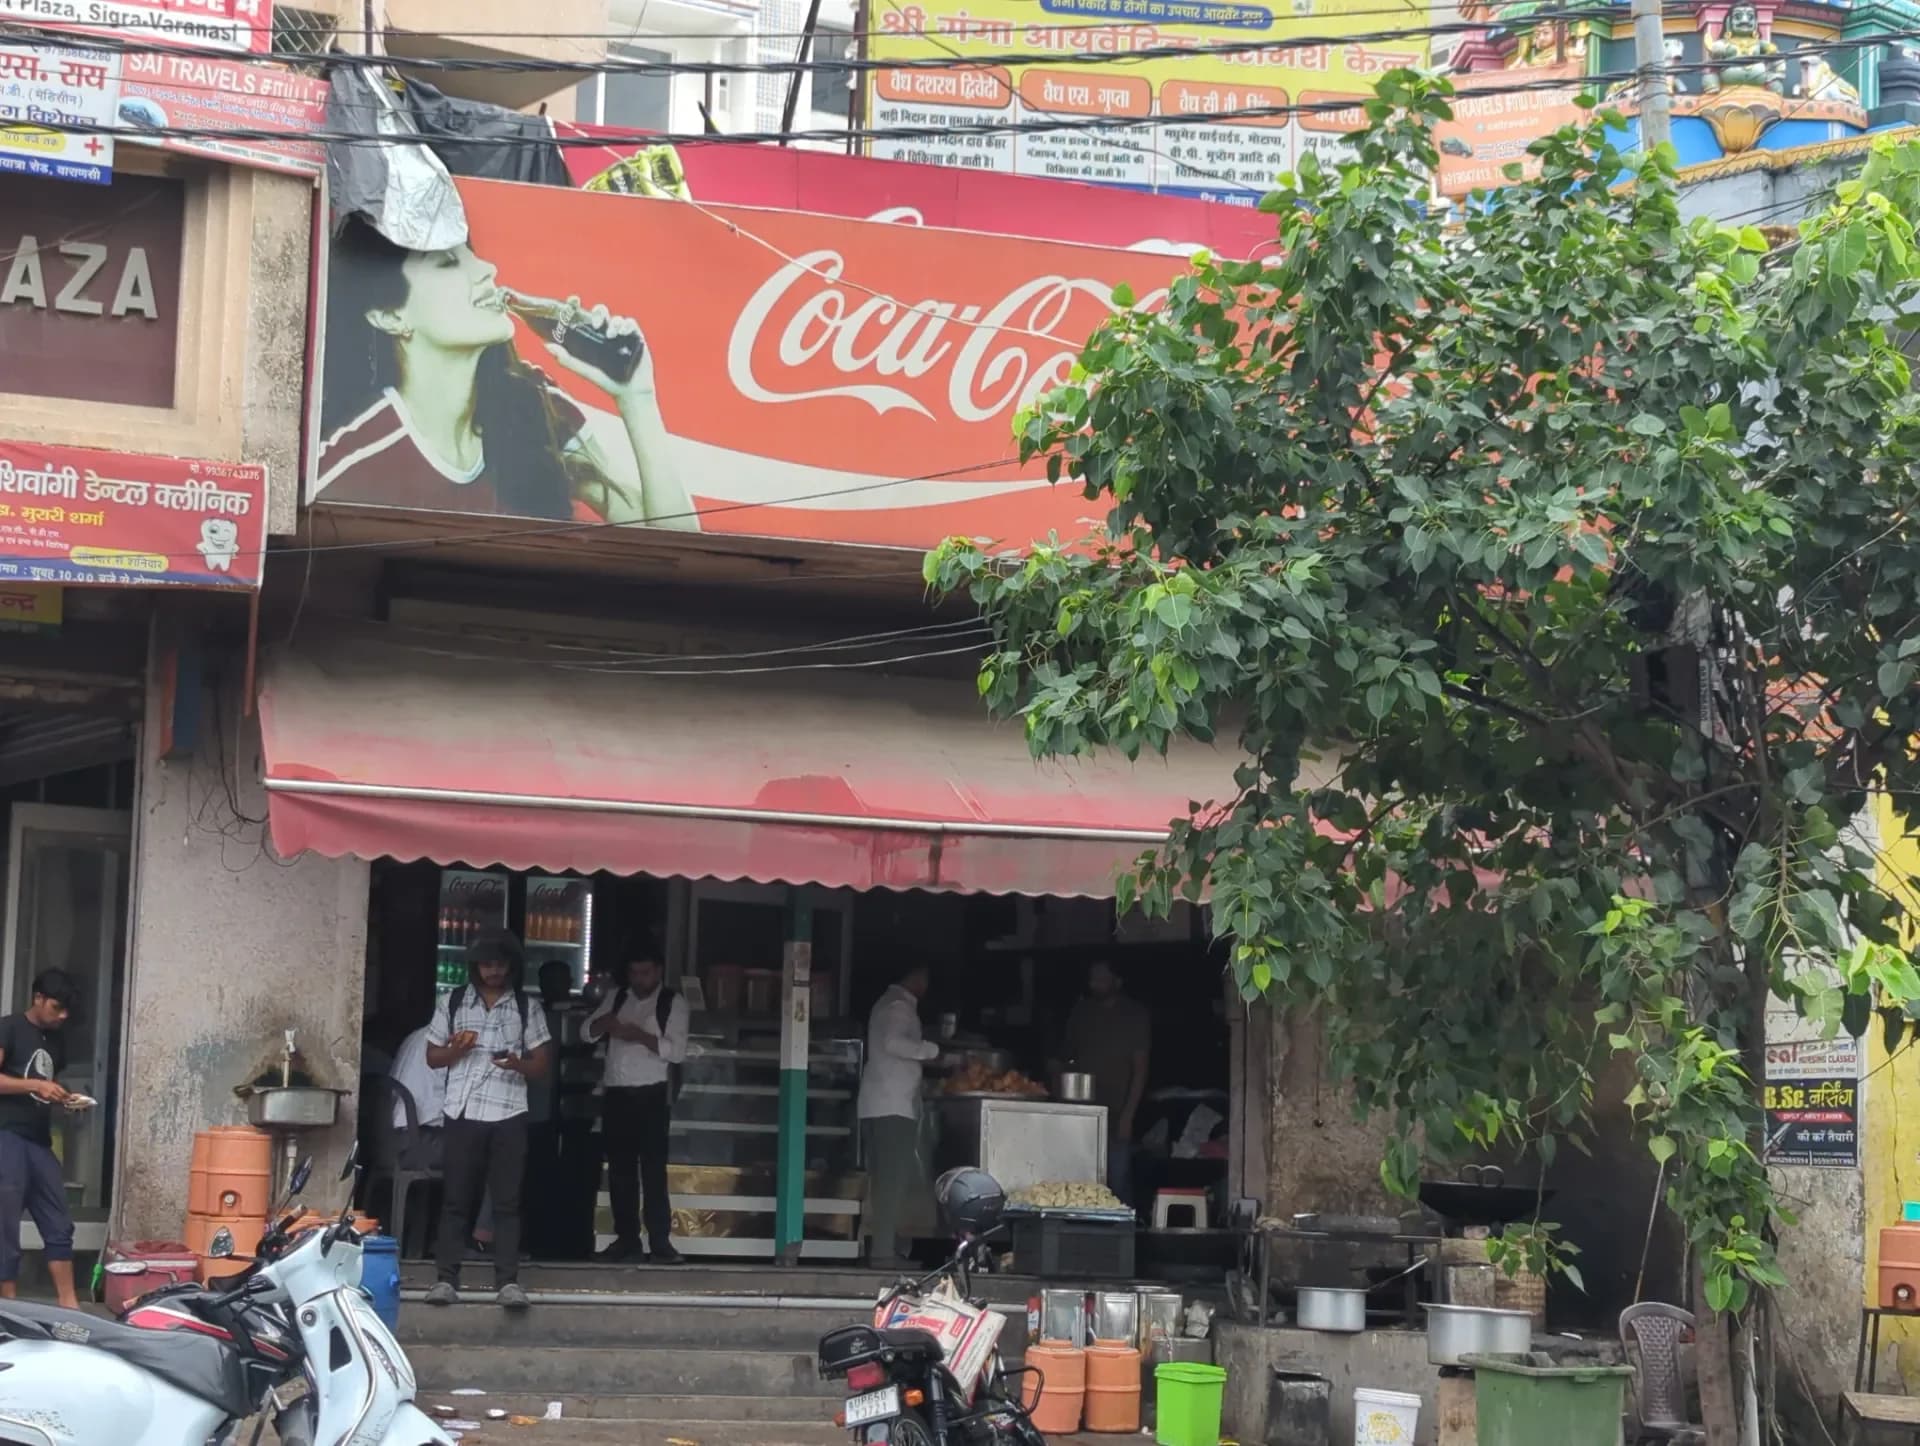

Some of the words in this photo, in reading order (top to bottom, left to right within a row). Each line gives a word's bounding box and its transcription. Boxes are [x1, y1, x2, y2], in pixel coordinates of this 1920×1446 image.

[60, 61, 108, 89] राय
[130, 53, 163, 75] SAI
[168, 57, 256, 94] TRAVELS
[0, 234, 159, 319] AZA
[727, 250, 1125, 423] Coca-Co
[83, 469, 151, 506] डेन्टल
[154, 480, 253, 515] क्लीनिक
